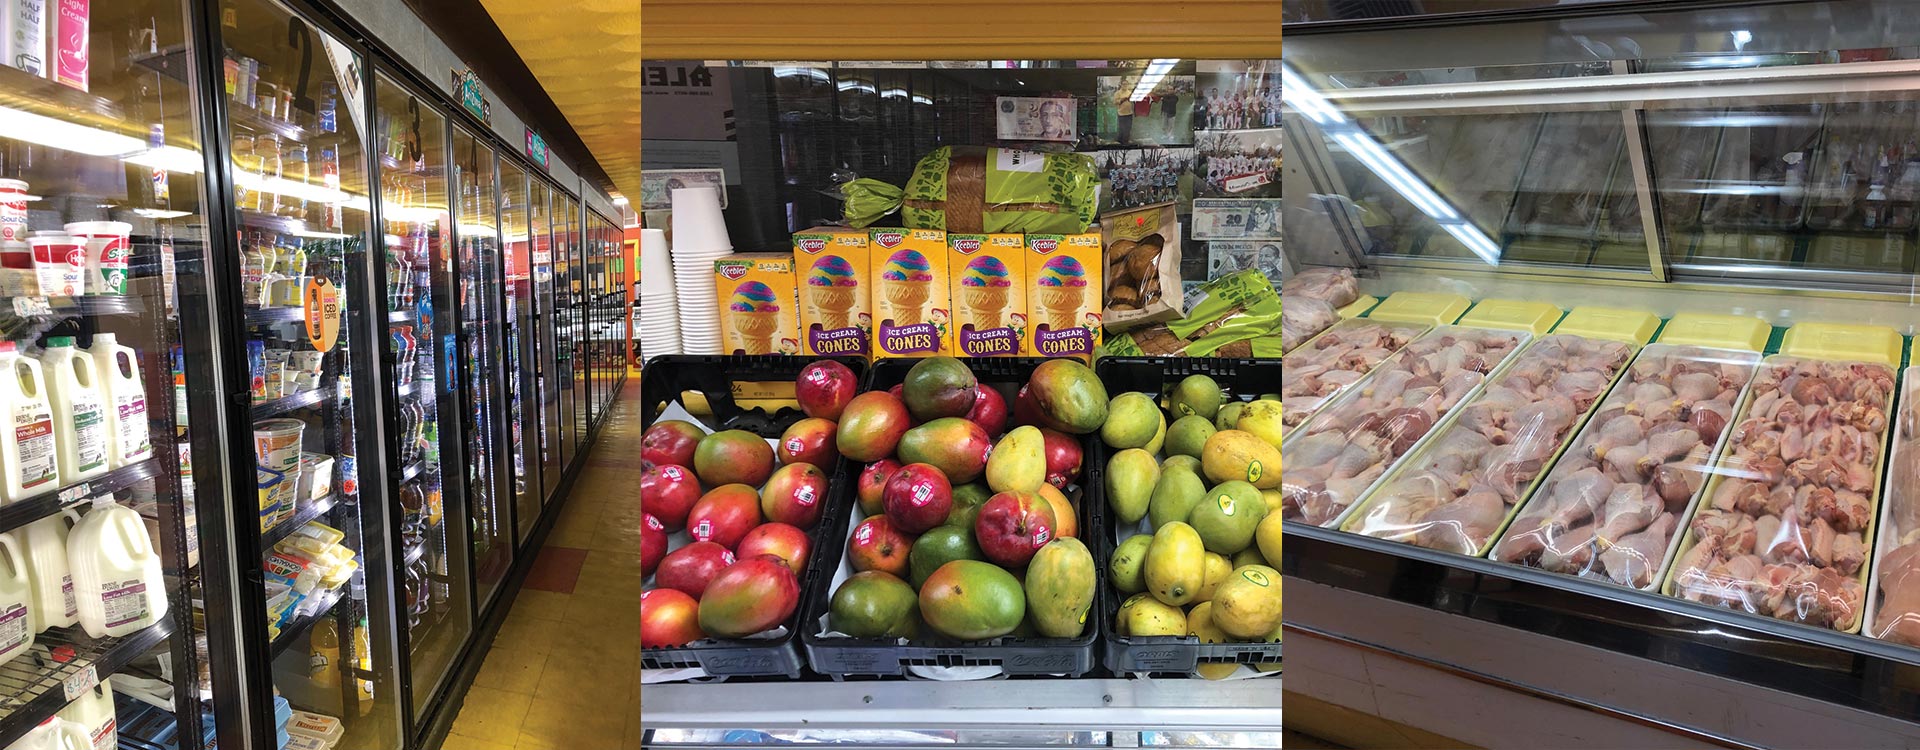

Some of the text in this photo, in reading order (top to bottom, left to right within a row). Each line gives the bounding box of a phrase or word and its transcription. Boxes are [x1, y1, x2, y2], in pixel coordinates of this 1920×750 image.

[20, 0, 40, 12] HALF
[20, 11, 40, 24] HALF
[61, 7, 86, 24] Cream
[288, 16, 316, 115] 2
[408, 96, 422, 162] 3
[1226, 214, 1242, 224] 20
[876, 233, 902, 244] Keebler
[800, 240, 825, 250] Keebler
[954, 240, 979, 249] Keebler
[1031, 240, 1057, 250] Keebler
[721, 266, 746, 276] Keebler
[324, 304, 336, 313] ICED
[830, 330, 857, 338] CREAM
[902, 326, 929, 335] CREAM
[982, 330, 1008, 338] CREAM
[1057, 330, 1083, 338] CREAM
[816, 338, 860, 354] CONES
[887, 334, 931, 351] CONES
[968, 337, 1011, 354] CONES
[1042, 337, 1085, 354] CONES
